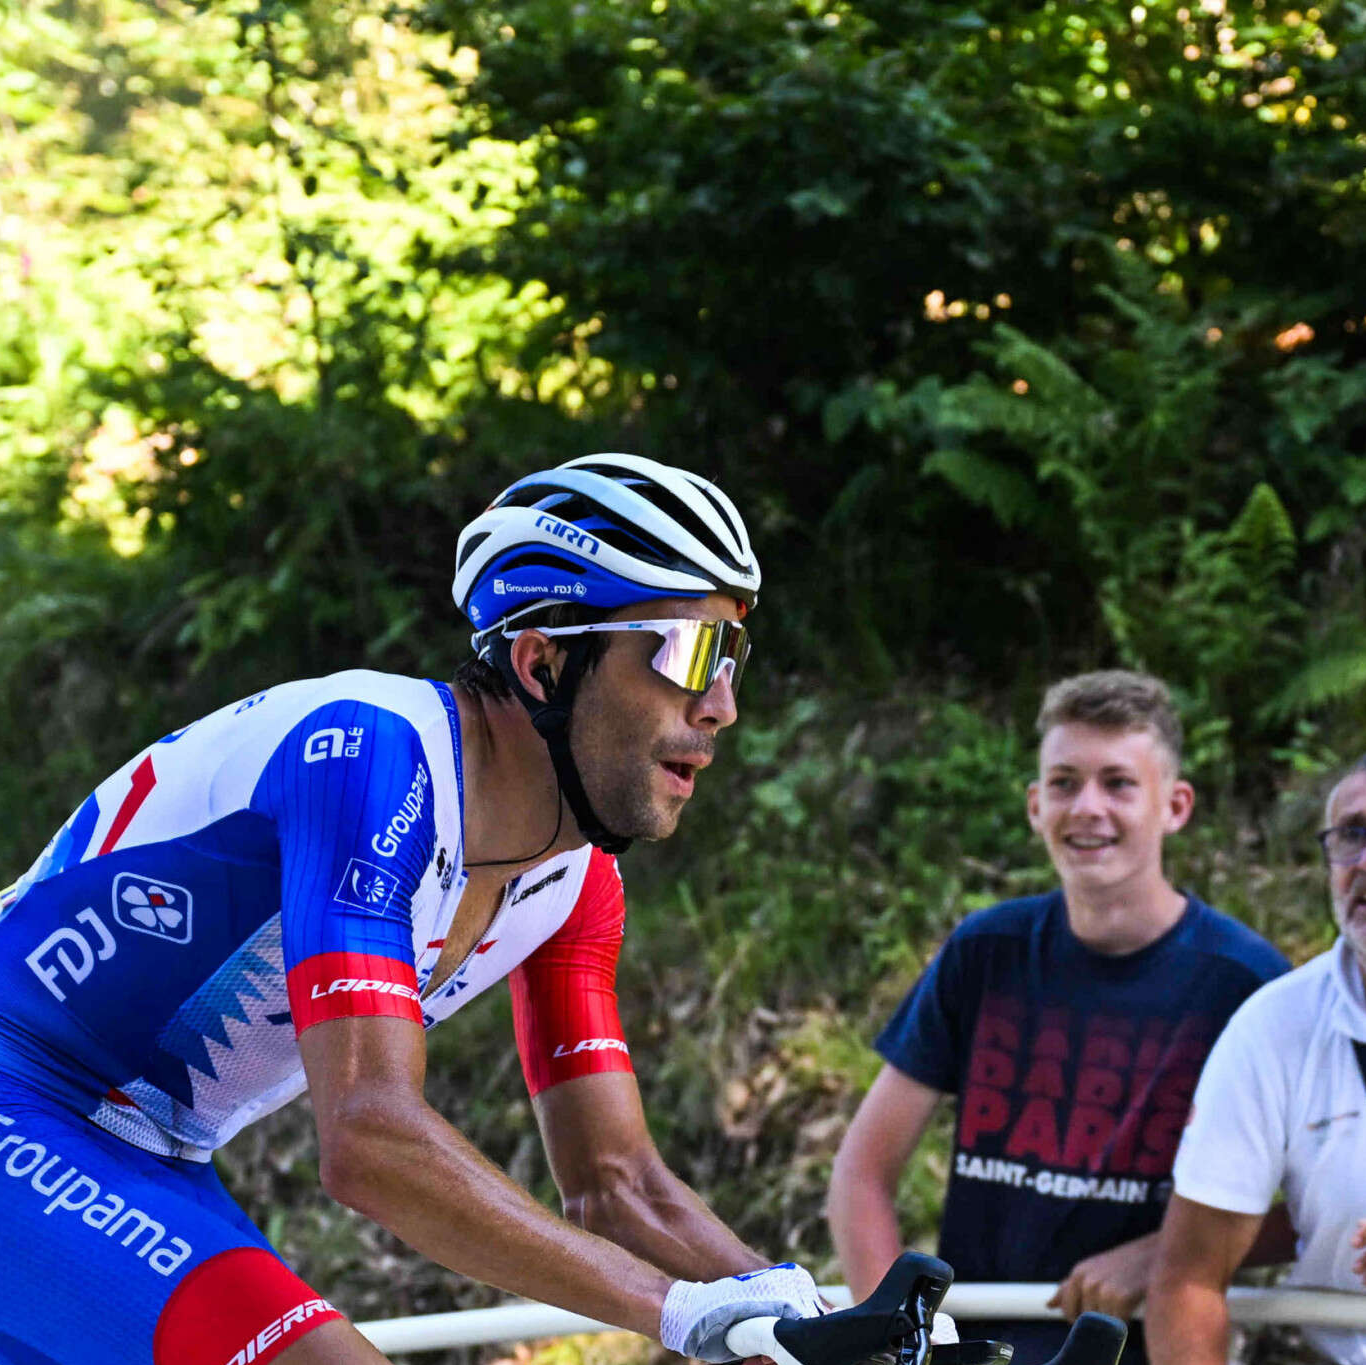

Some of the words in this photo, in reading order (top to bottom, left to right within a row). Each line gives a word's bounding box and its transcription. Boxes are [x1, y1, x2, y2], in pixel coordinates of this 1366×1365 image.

[535, 515, 600, 556] GIRO
[505, 583, 549, 594] Groupama
[371, 763, 429, 858] Groupama
[25, 907, 117, 1003] FDJ
[958, 1084, 1185, 1175] PARIS
